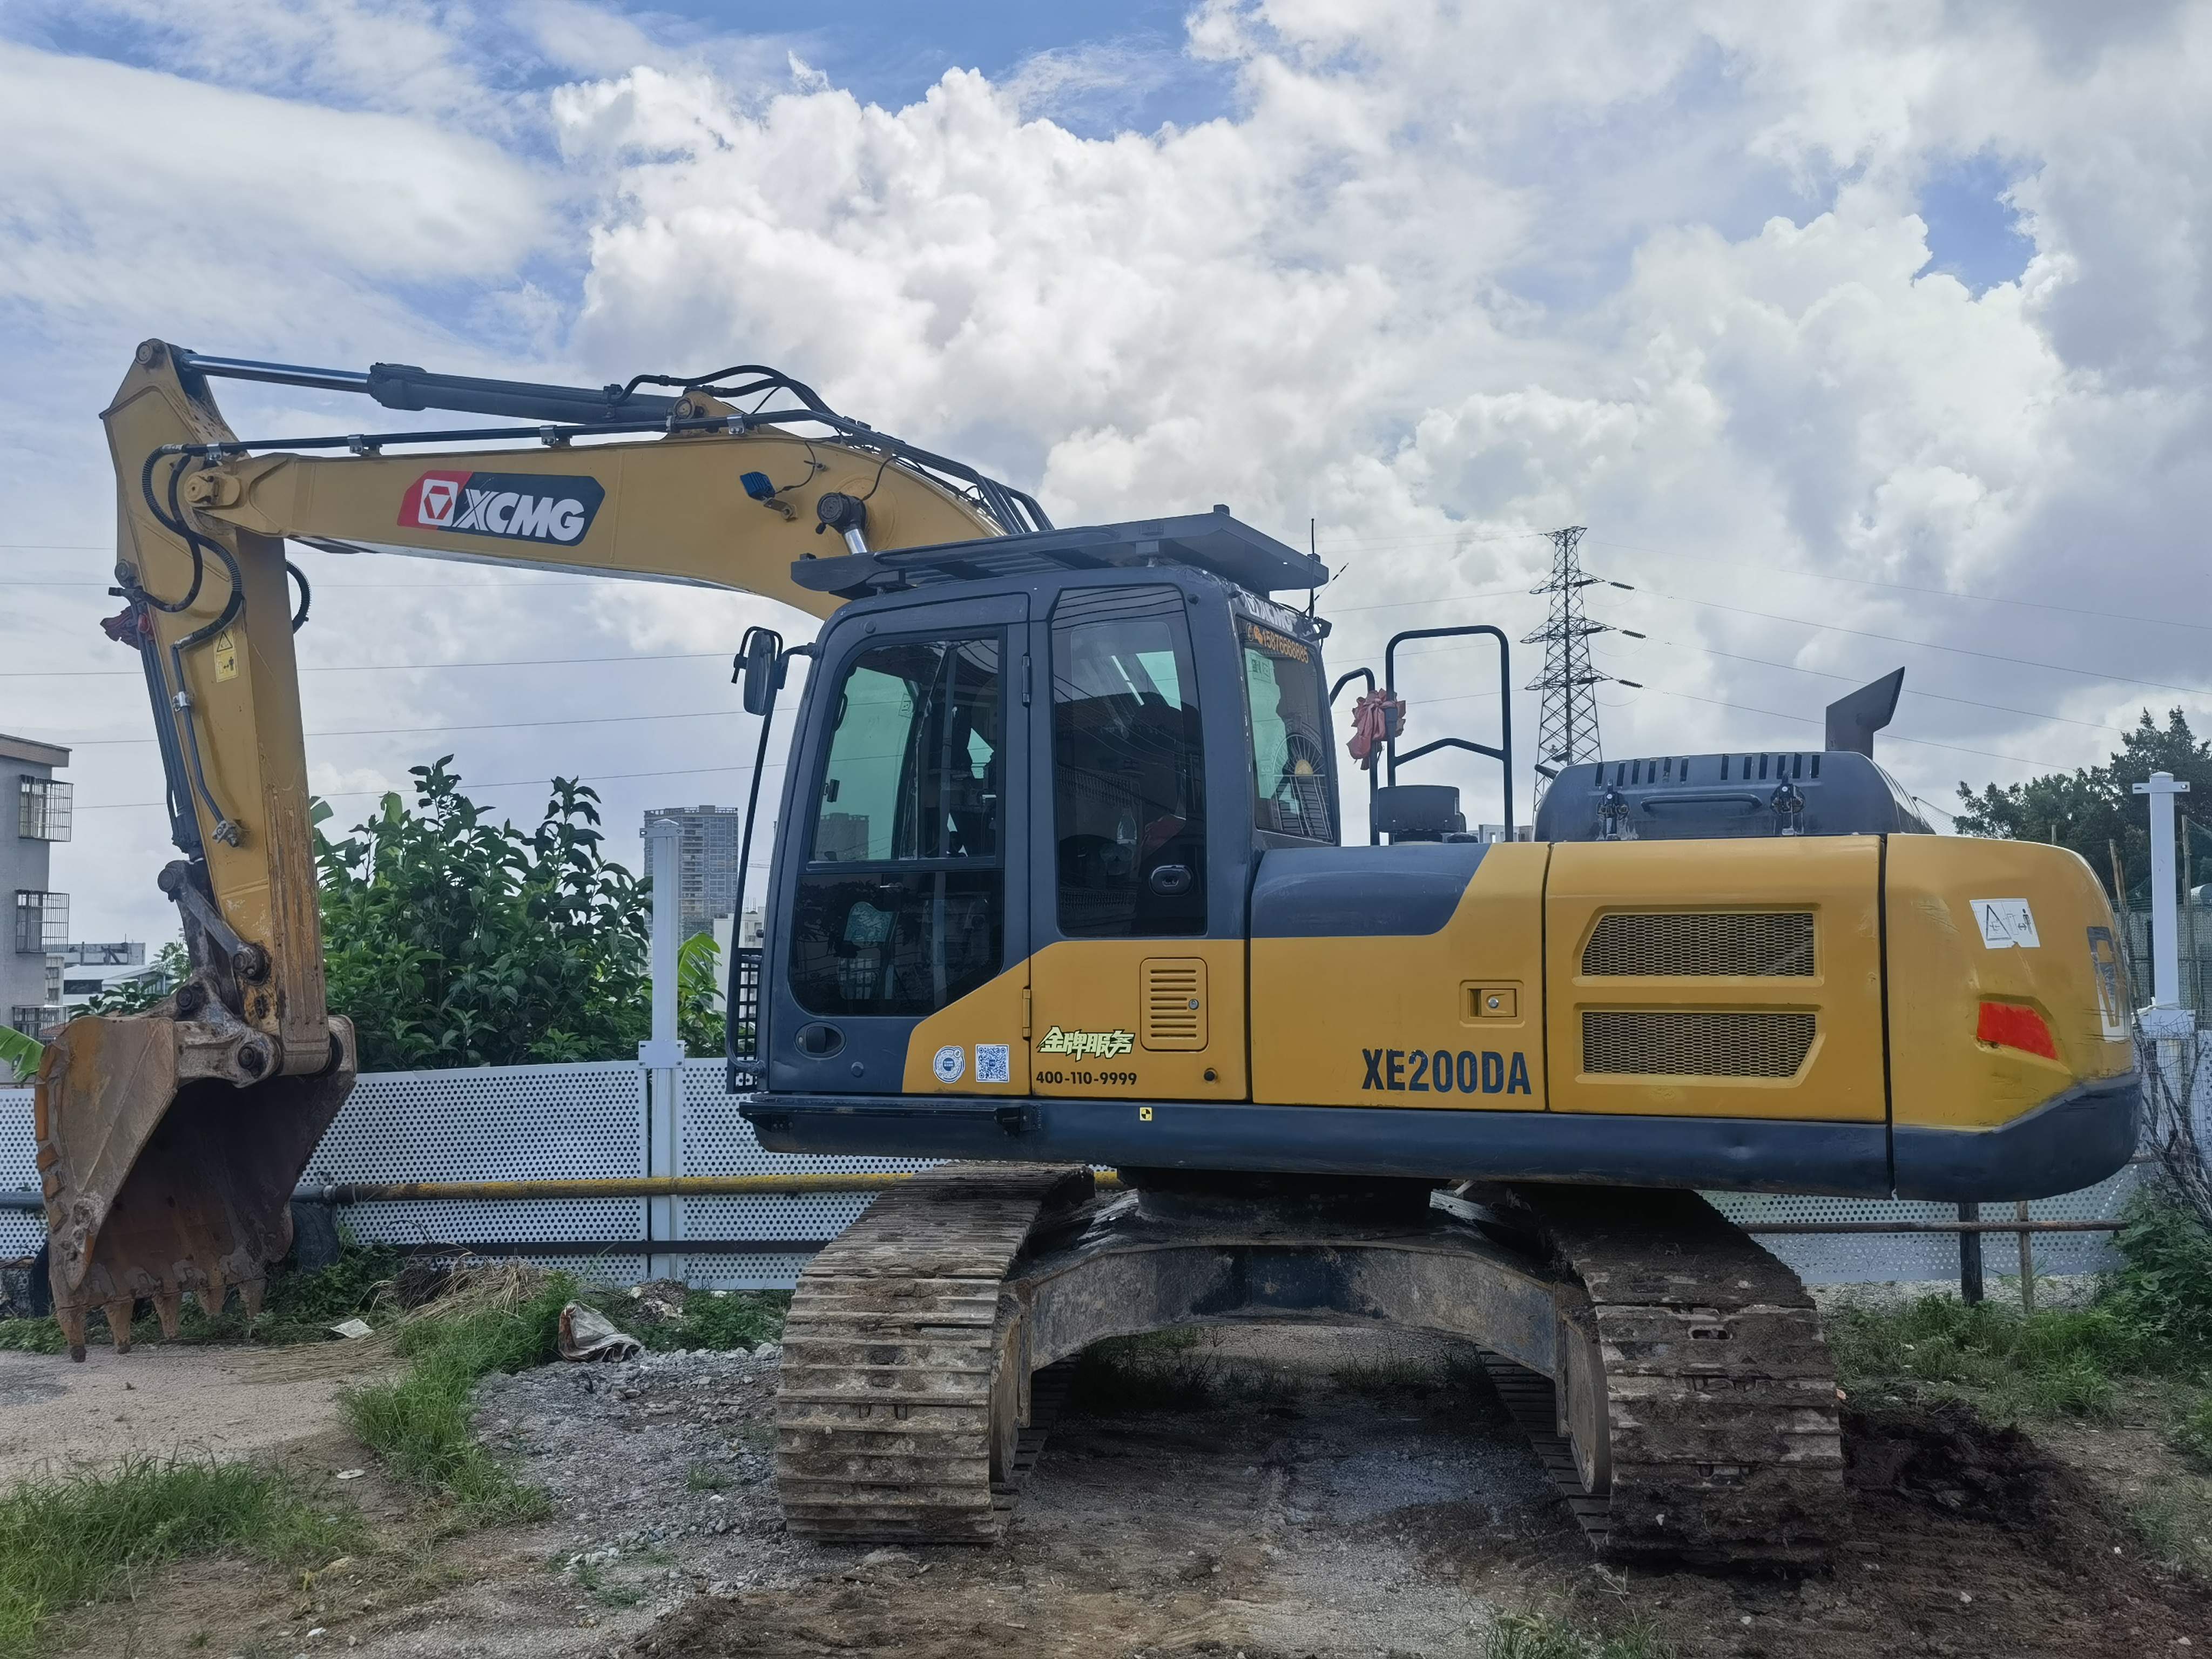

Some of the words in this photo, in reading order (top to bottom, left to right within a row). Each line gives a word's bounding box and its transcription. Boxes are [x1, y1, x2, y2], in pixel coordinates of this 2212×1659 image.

[452, 489, 584, 541] XCMG
[1258, 600, 1297, 632] XCMG
[1037, 1026, 1135, 1062] 金牌服务
[1036, 1071, 1137, 1085] 400-110-9999
[1361, 1048, 1532, 1095] XE200DA
